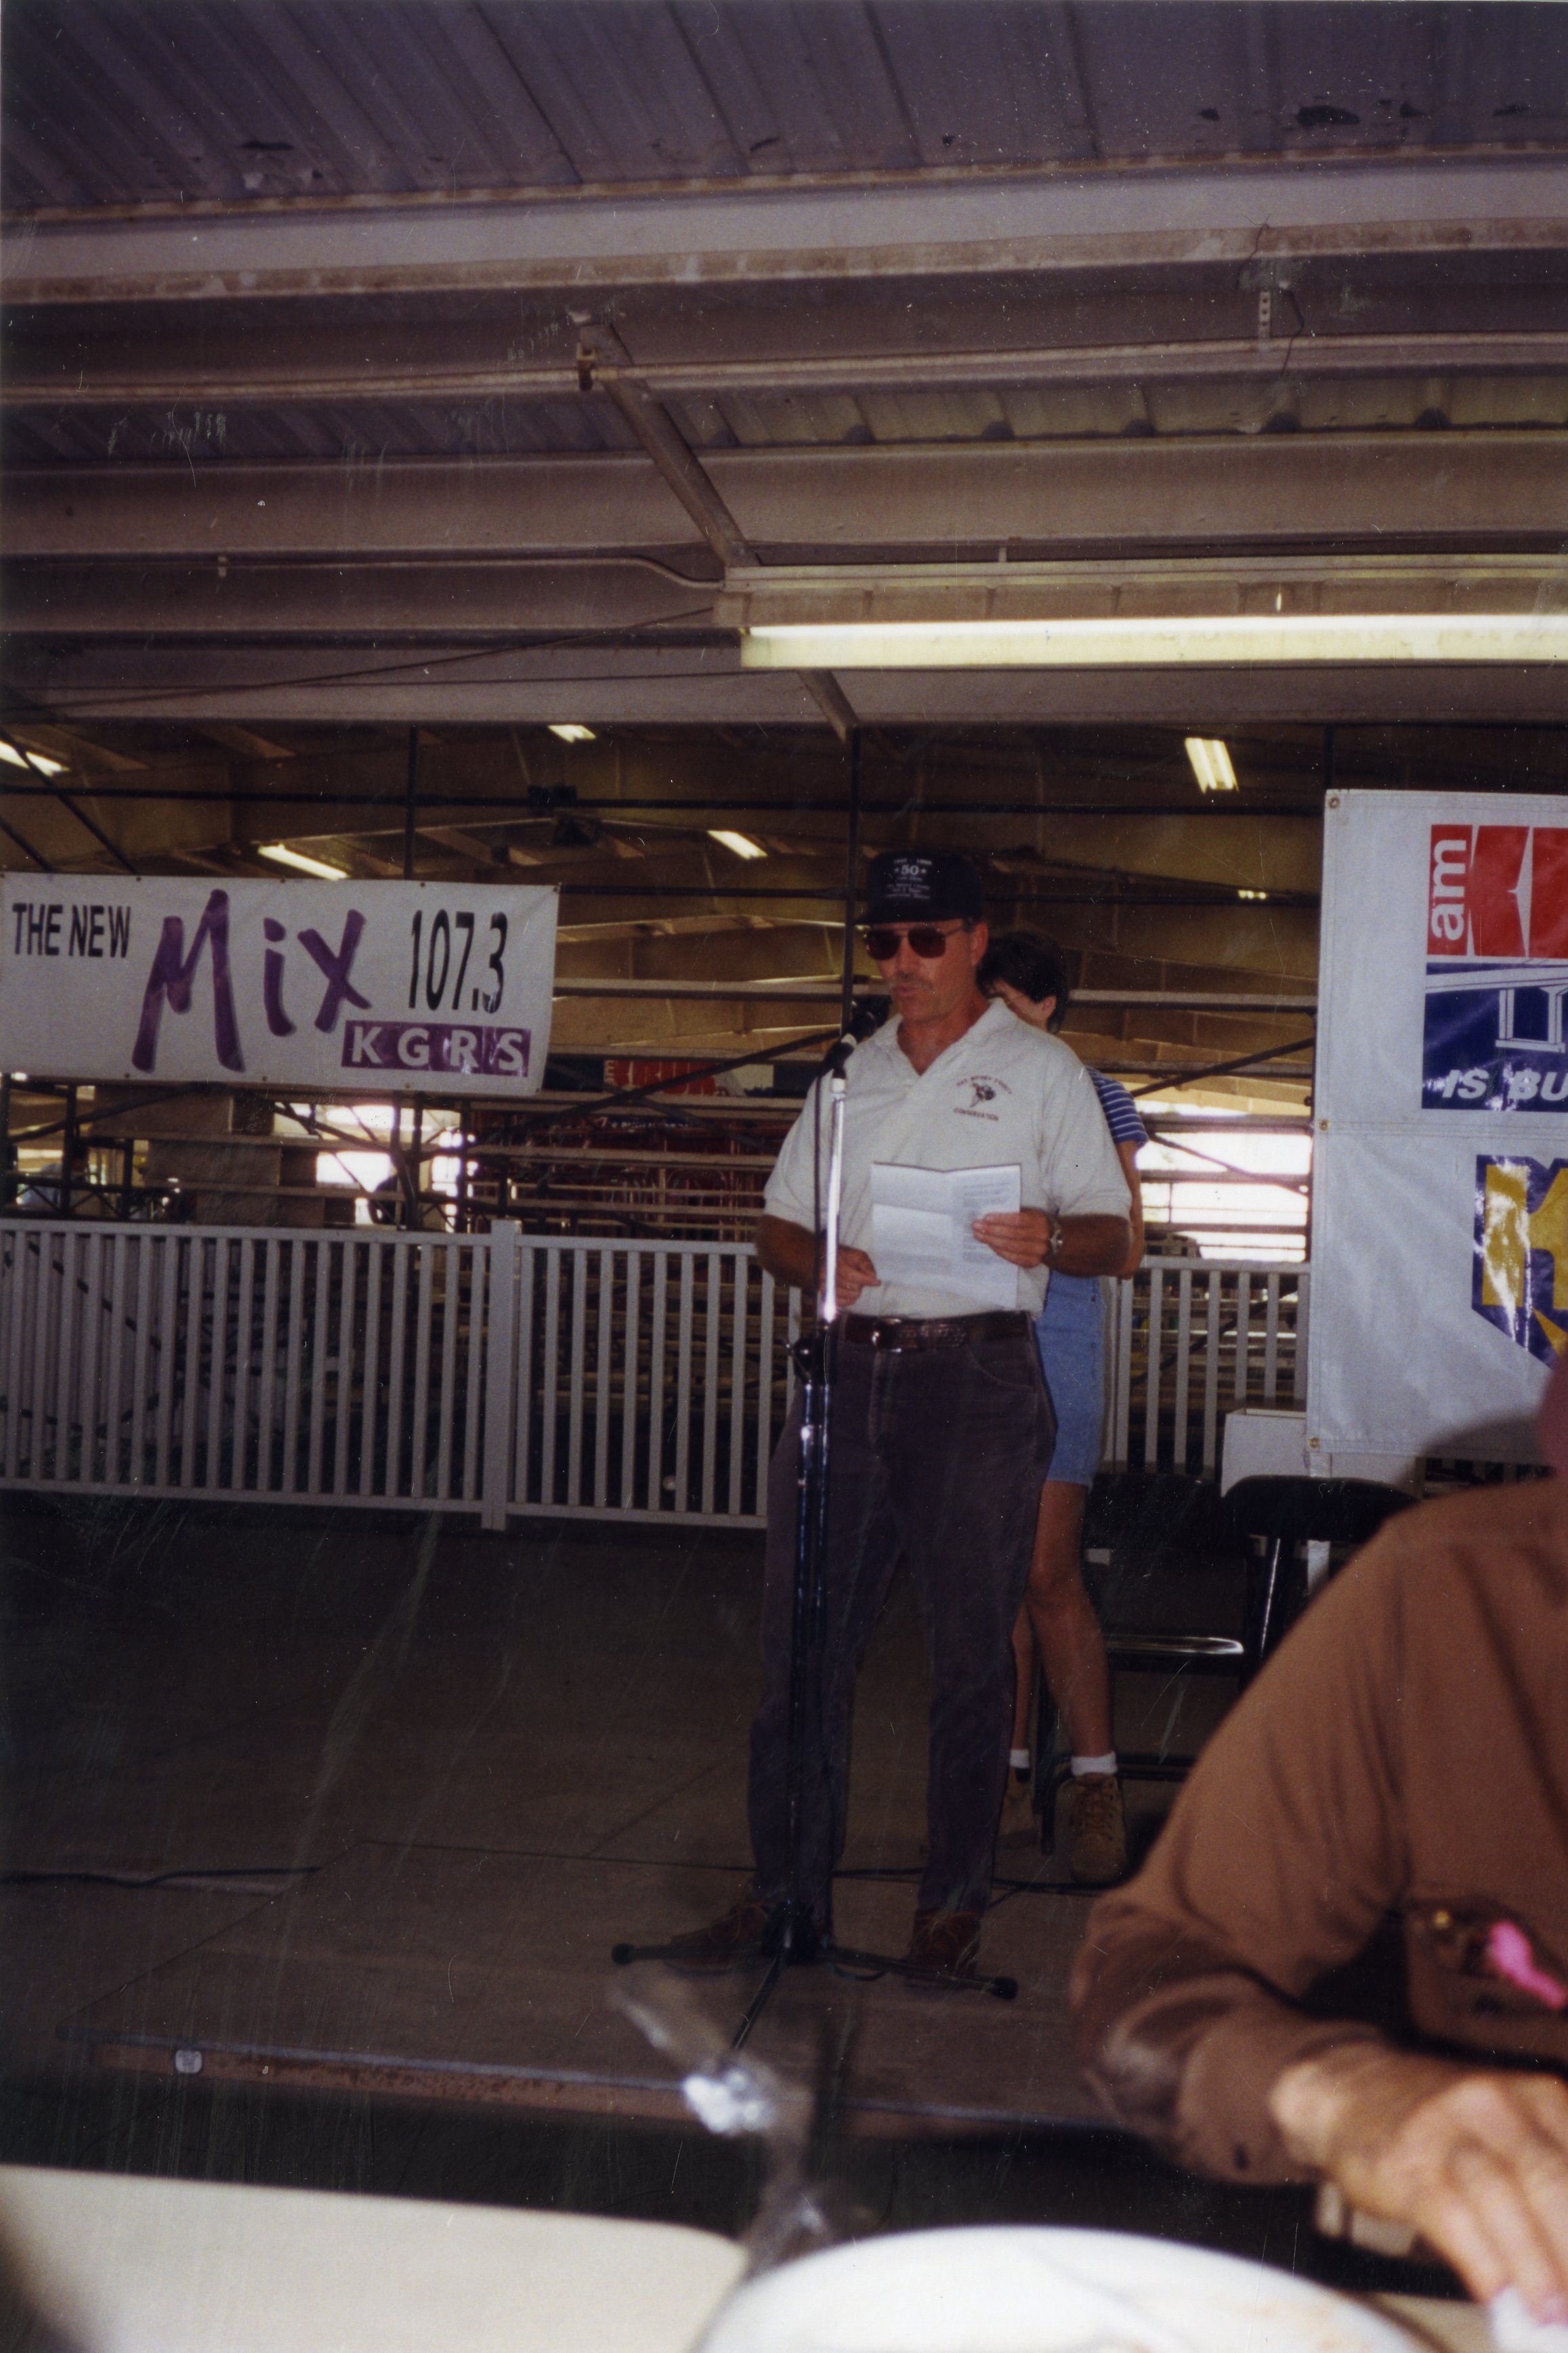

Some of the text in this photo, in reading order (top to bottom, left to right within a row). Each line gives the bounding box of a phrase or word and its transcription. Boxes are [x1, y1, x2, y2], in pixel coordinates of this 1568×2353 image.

[1431, 839, 1466, 941] am
[12, 888, 509, 1074] THE NEW Mix 107.3
[351, 1023, 524, 1072] KGRS
[1441, 1068, 1489, 1099] IS
